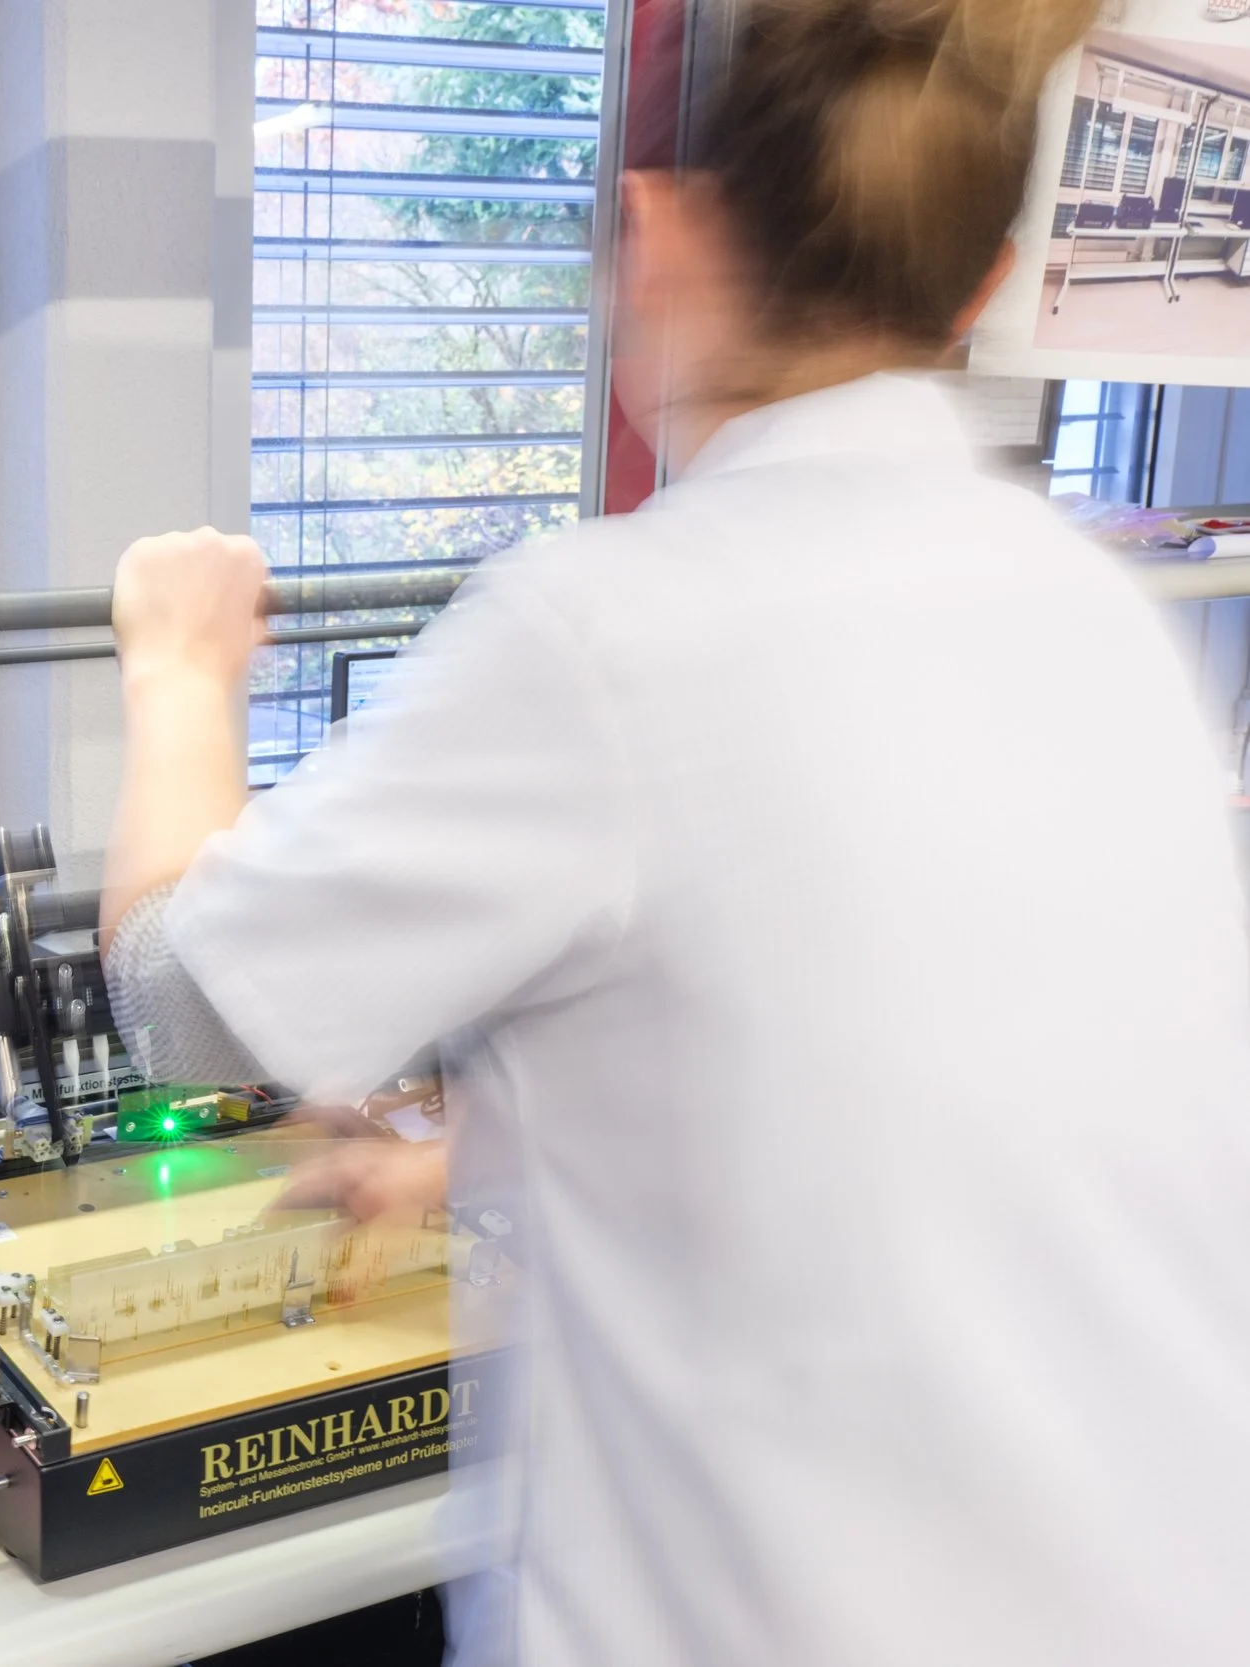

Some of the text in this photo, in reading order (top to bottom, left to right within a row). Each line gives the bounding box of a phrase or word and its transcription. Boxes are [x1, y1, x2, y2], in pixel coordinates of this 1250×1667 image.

[200, 1379, 480, 1485] REINHARDT
[199, 1435, 479, 1519] Incircuit-Funktionstestsysteme und Prüfadapter
[200, 1482, 237, 1498] System-
[239, 1473, 258, 1486] und
[258, 1457, 325, 1481] Messelectronic
